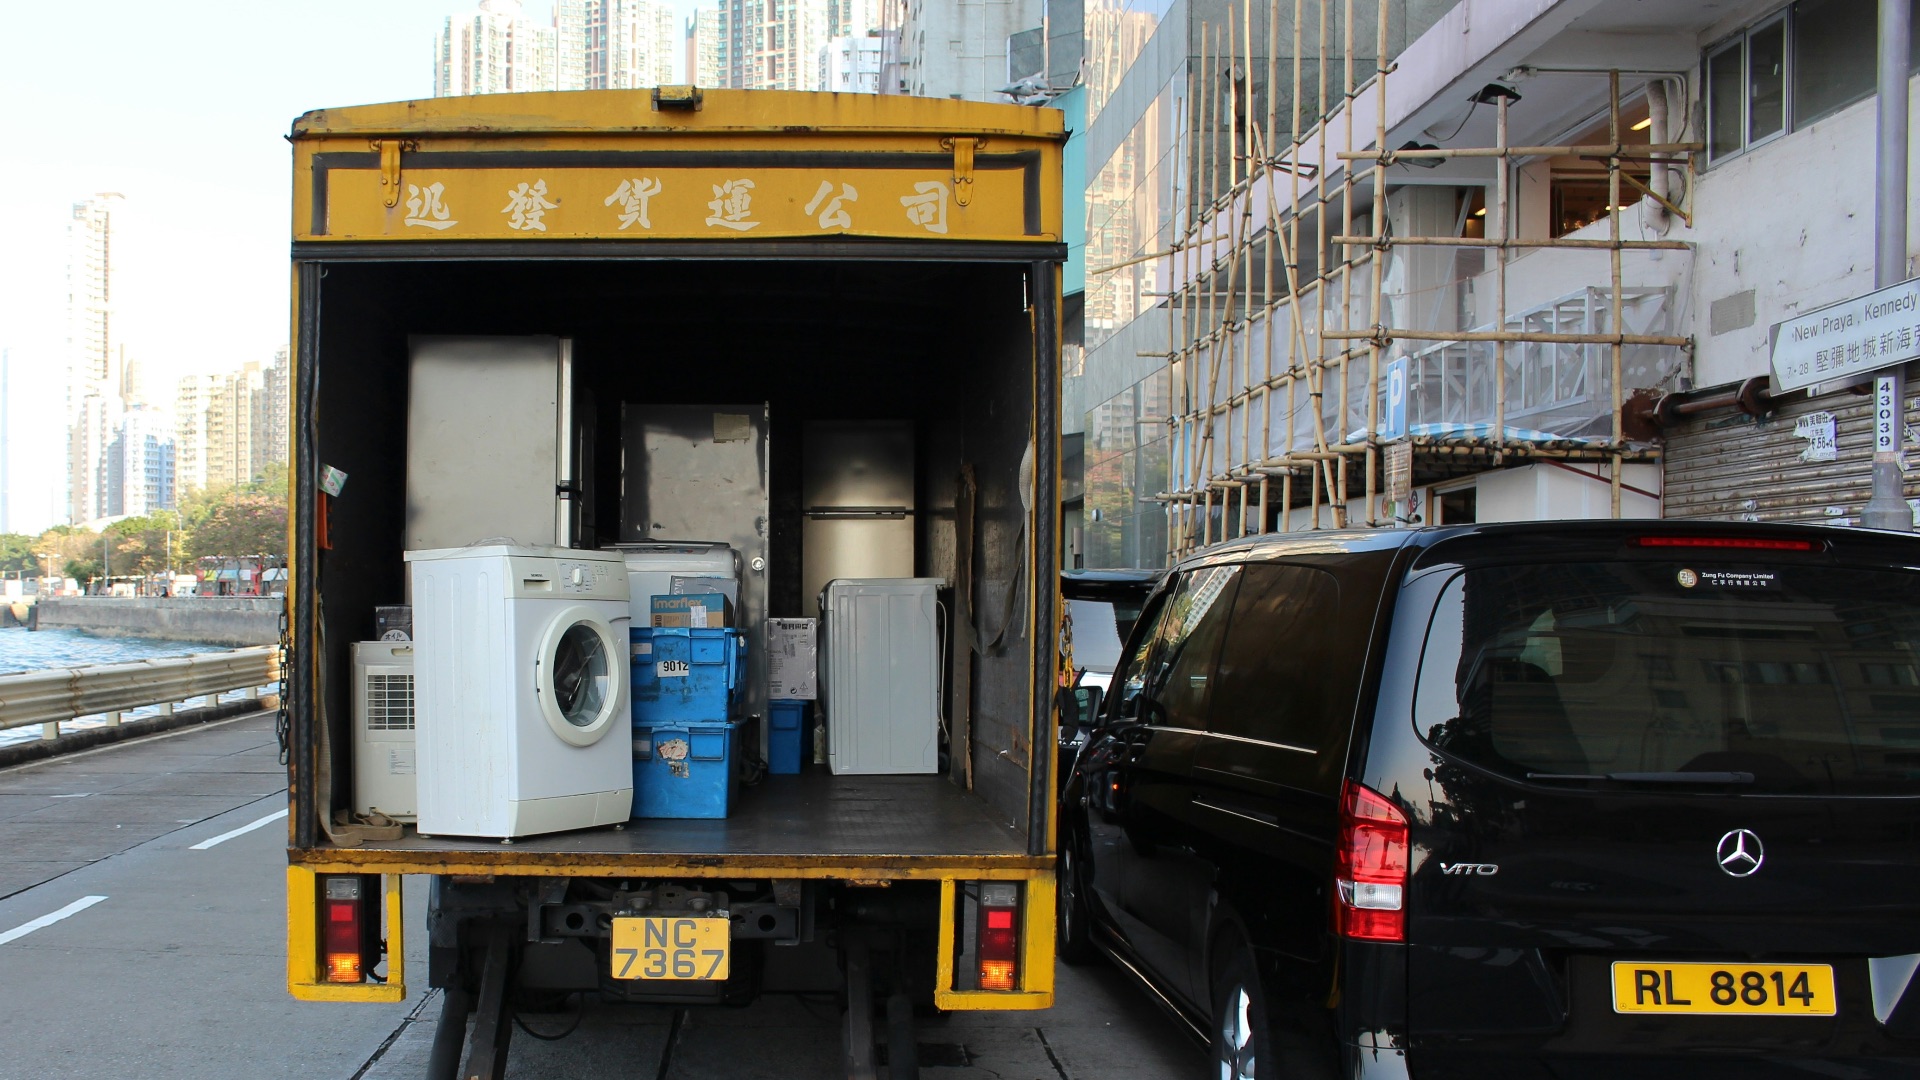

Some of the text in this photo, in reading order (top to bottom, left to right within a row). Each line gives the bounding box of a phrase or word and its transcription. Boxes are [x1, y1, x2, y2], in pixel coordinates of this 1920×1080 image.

[1794, 323, 1818, 342] New
[1864, 290, 1918, 322] Kennedy
[1388, 367, 1403, 432] P
[1879, 381, 1892, 447] 43039
[1725, 572, 1752, 580] Company
[653, 596, 703, 609] imarflex
[663, 660, 689, 672] 9012
[1440, 862, 1499, 876] VITO
[645, 919, 697, 949] NC
[615, 948, 725, 979] 7367
[1634, 969, 1815, 1007] RL 8814
